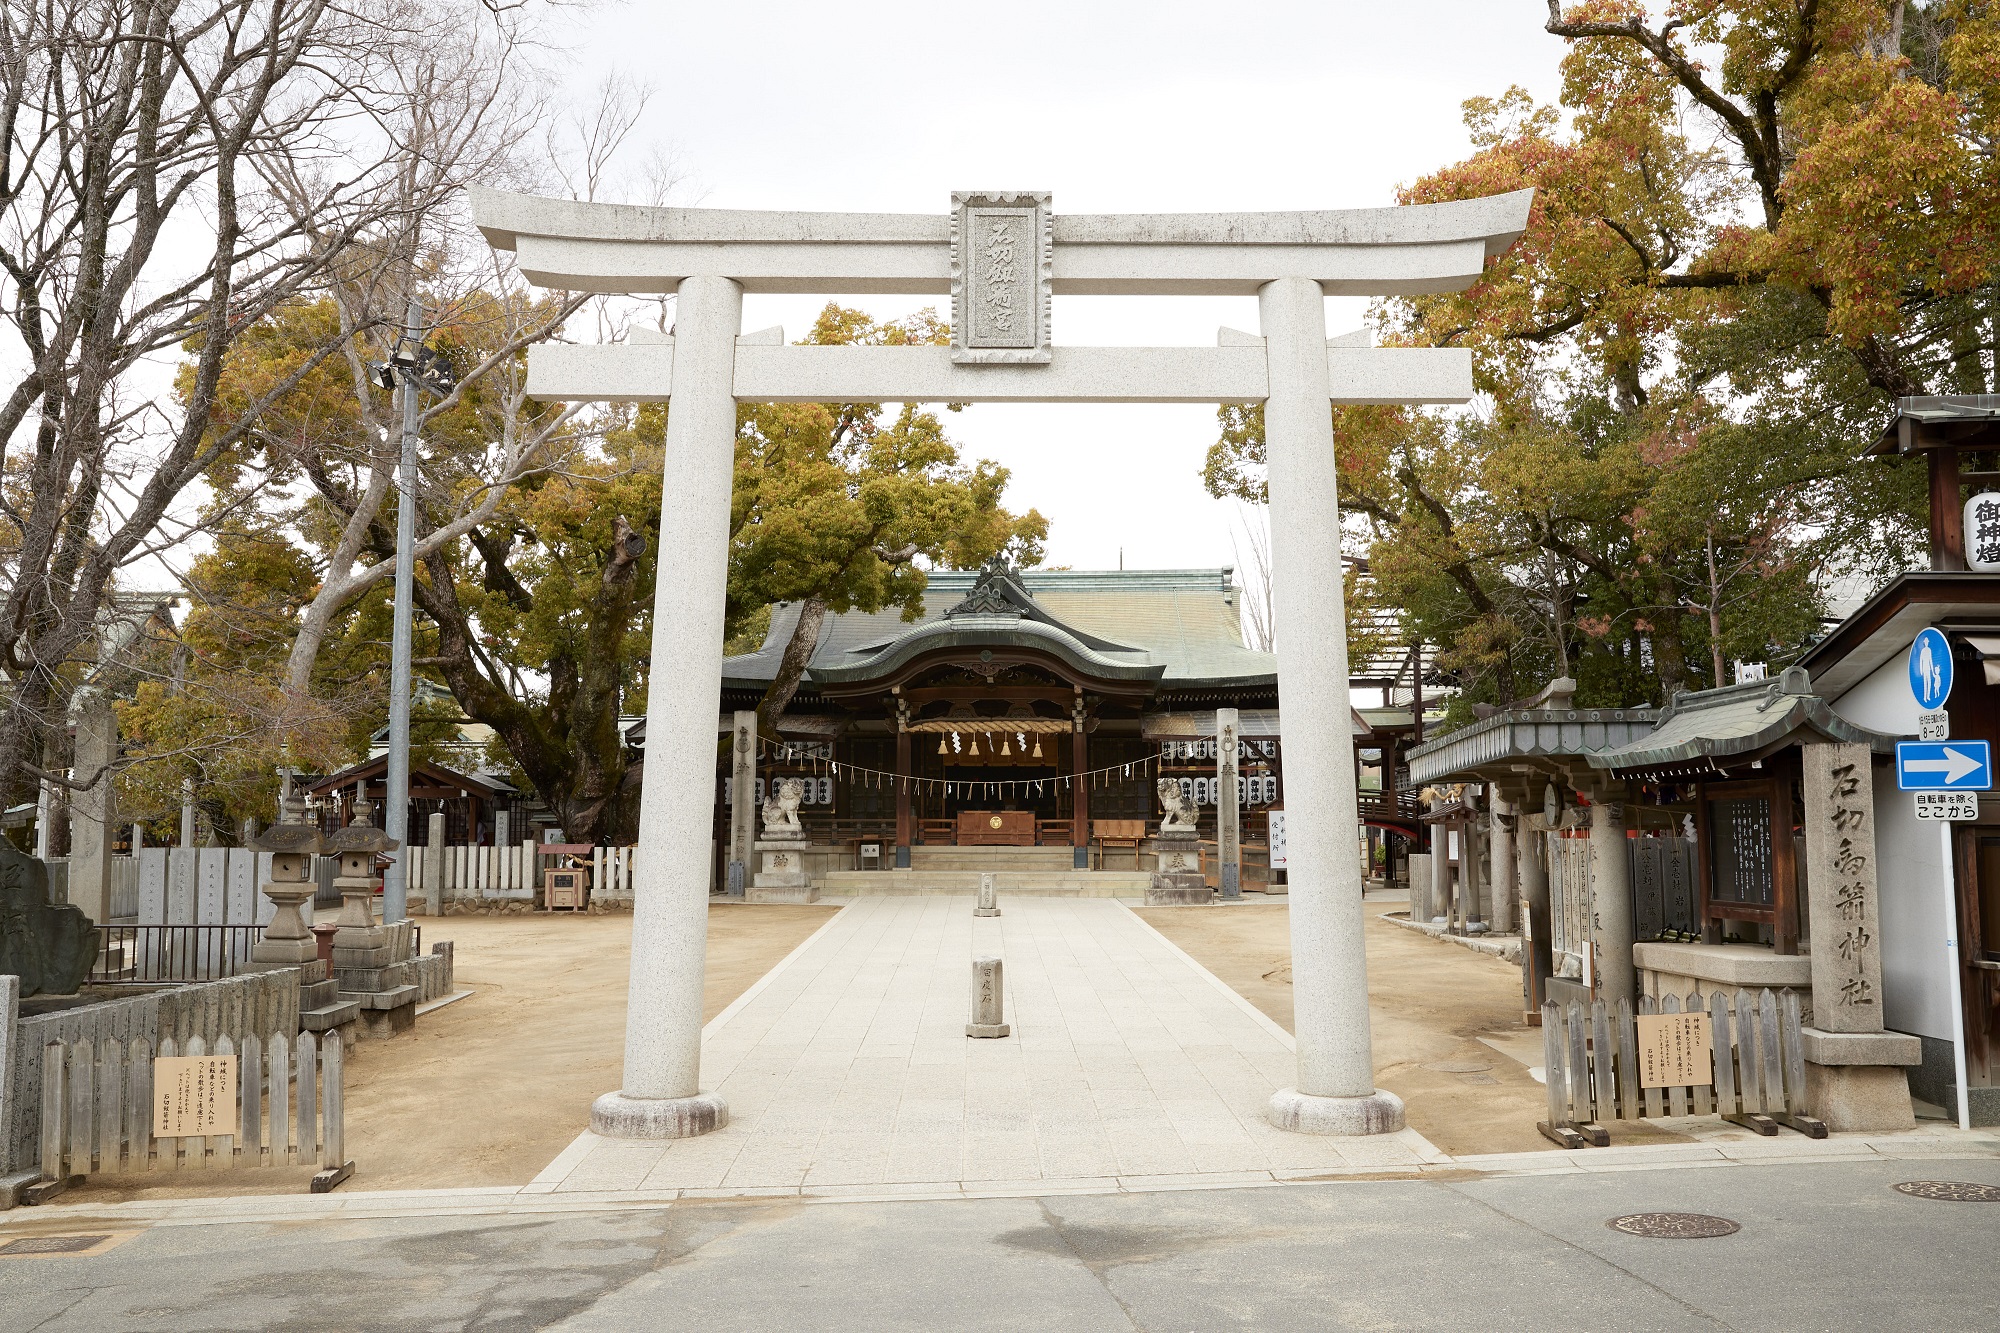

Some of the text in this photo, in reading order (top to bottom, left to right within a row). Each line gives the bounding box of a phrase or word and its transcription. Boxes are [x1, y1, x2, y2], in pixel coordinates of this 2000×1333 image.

[1918, 795, 1974, 804] 自転車を除く
[1918, 806, 1976, 818] ここから
